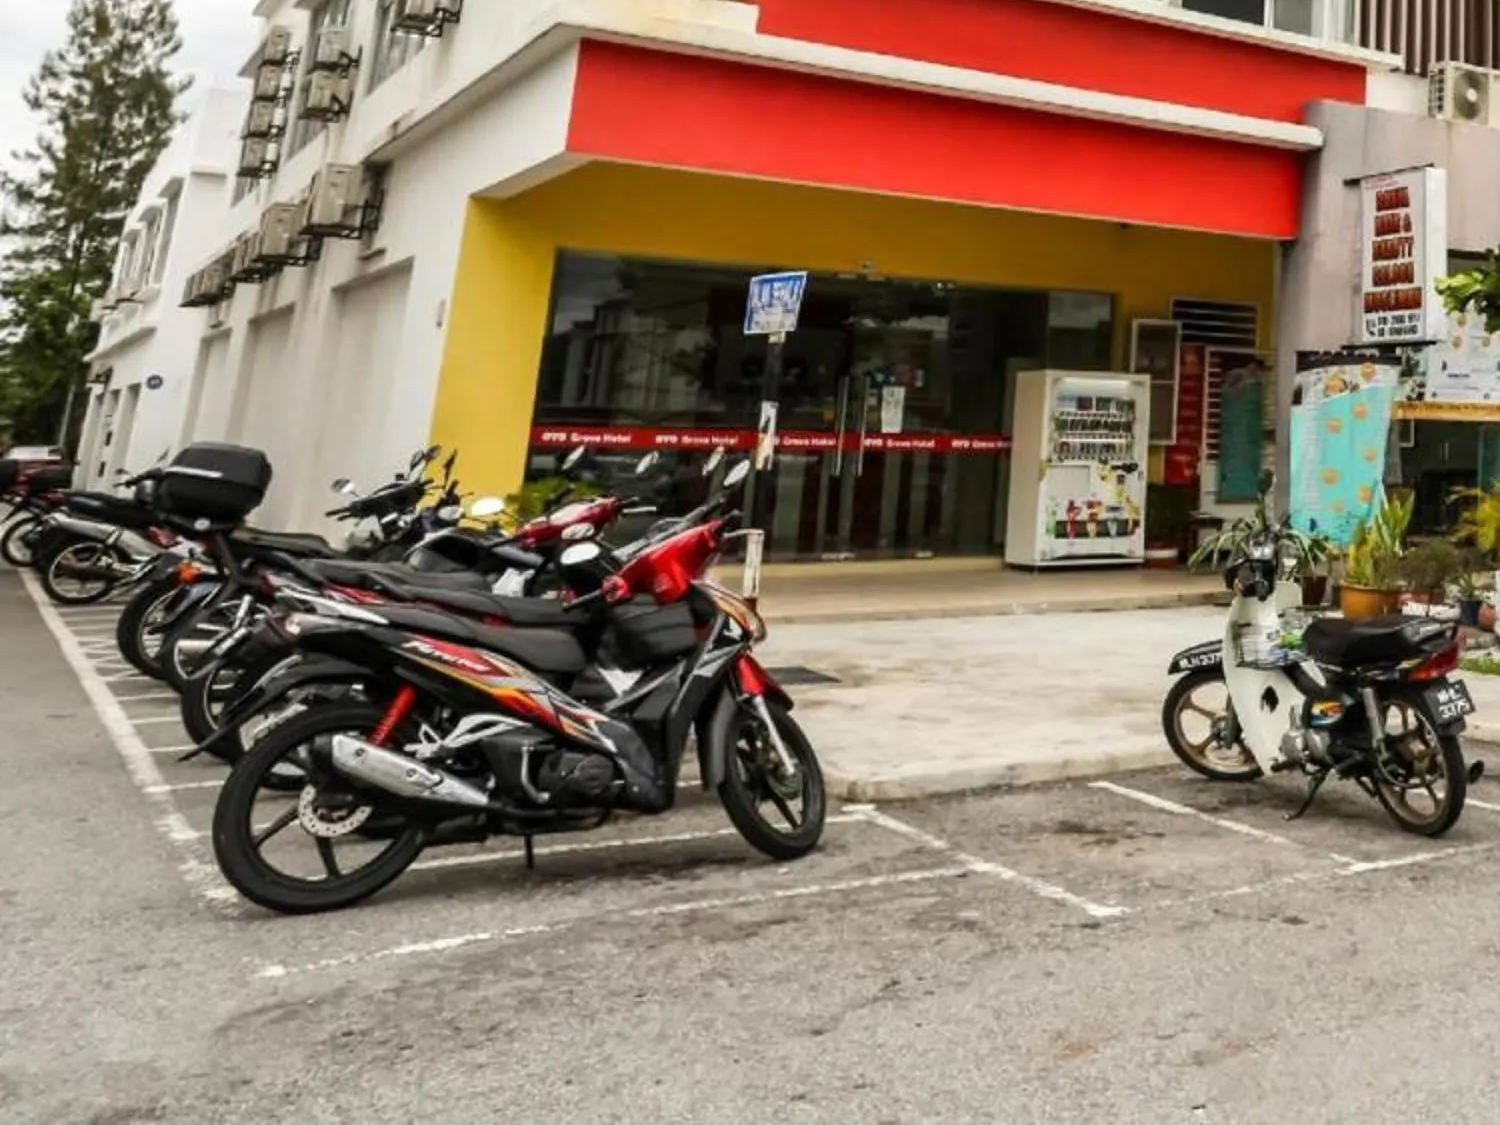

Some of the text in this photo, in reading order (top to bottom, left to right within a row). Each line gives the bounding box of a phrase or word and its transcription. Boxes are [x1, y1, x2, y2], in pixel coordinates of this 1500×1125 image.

[542, 432, 632, 444] OYO Grove Hotel
[655, 433, 678, 444] OYO
